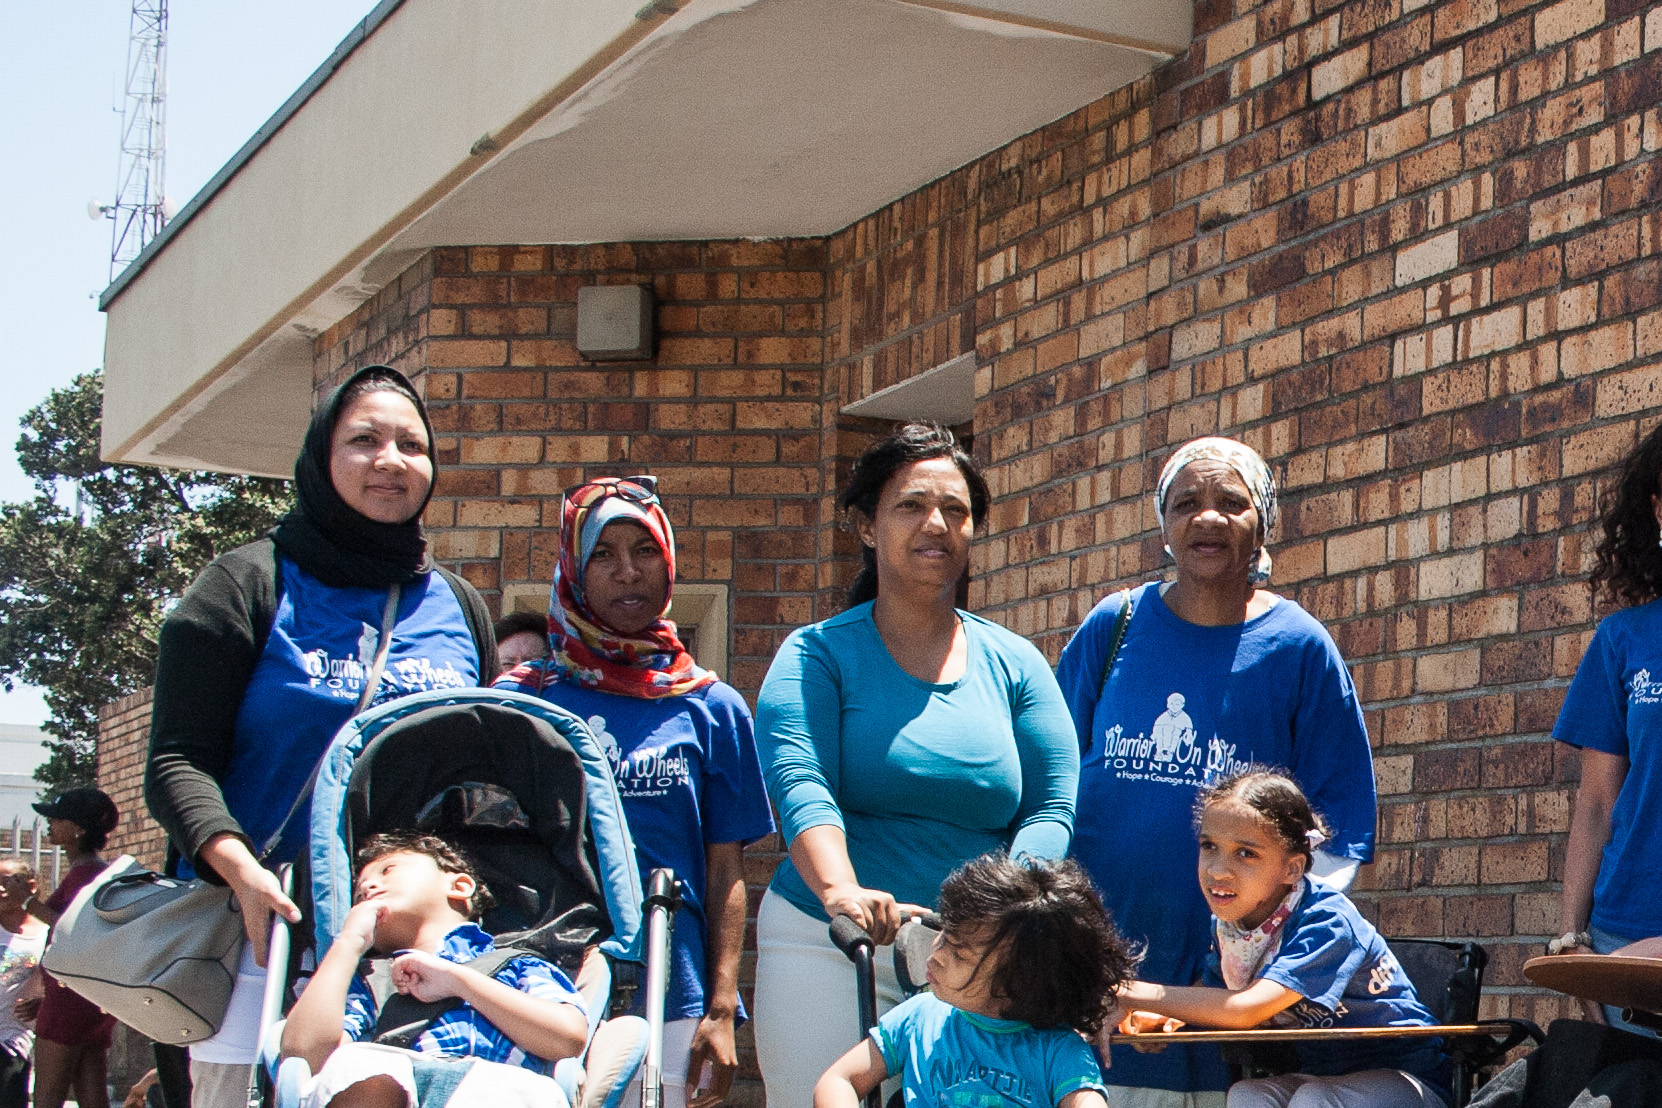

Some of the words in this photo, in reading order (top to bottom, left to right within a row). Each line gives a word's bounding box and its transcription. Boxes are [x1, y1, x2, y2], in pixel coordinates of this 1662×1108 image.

[633, 746, 690, 778] Wheels
[1103, 723, 1155, 760] Warrior
[1176, 729, 1202, 766] On
[1206, 737, 1255, 776] Wheel
[1122, 770, 1143, 782] Hope
[1150, 772, 1184, 787] Courage
